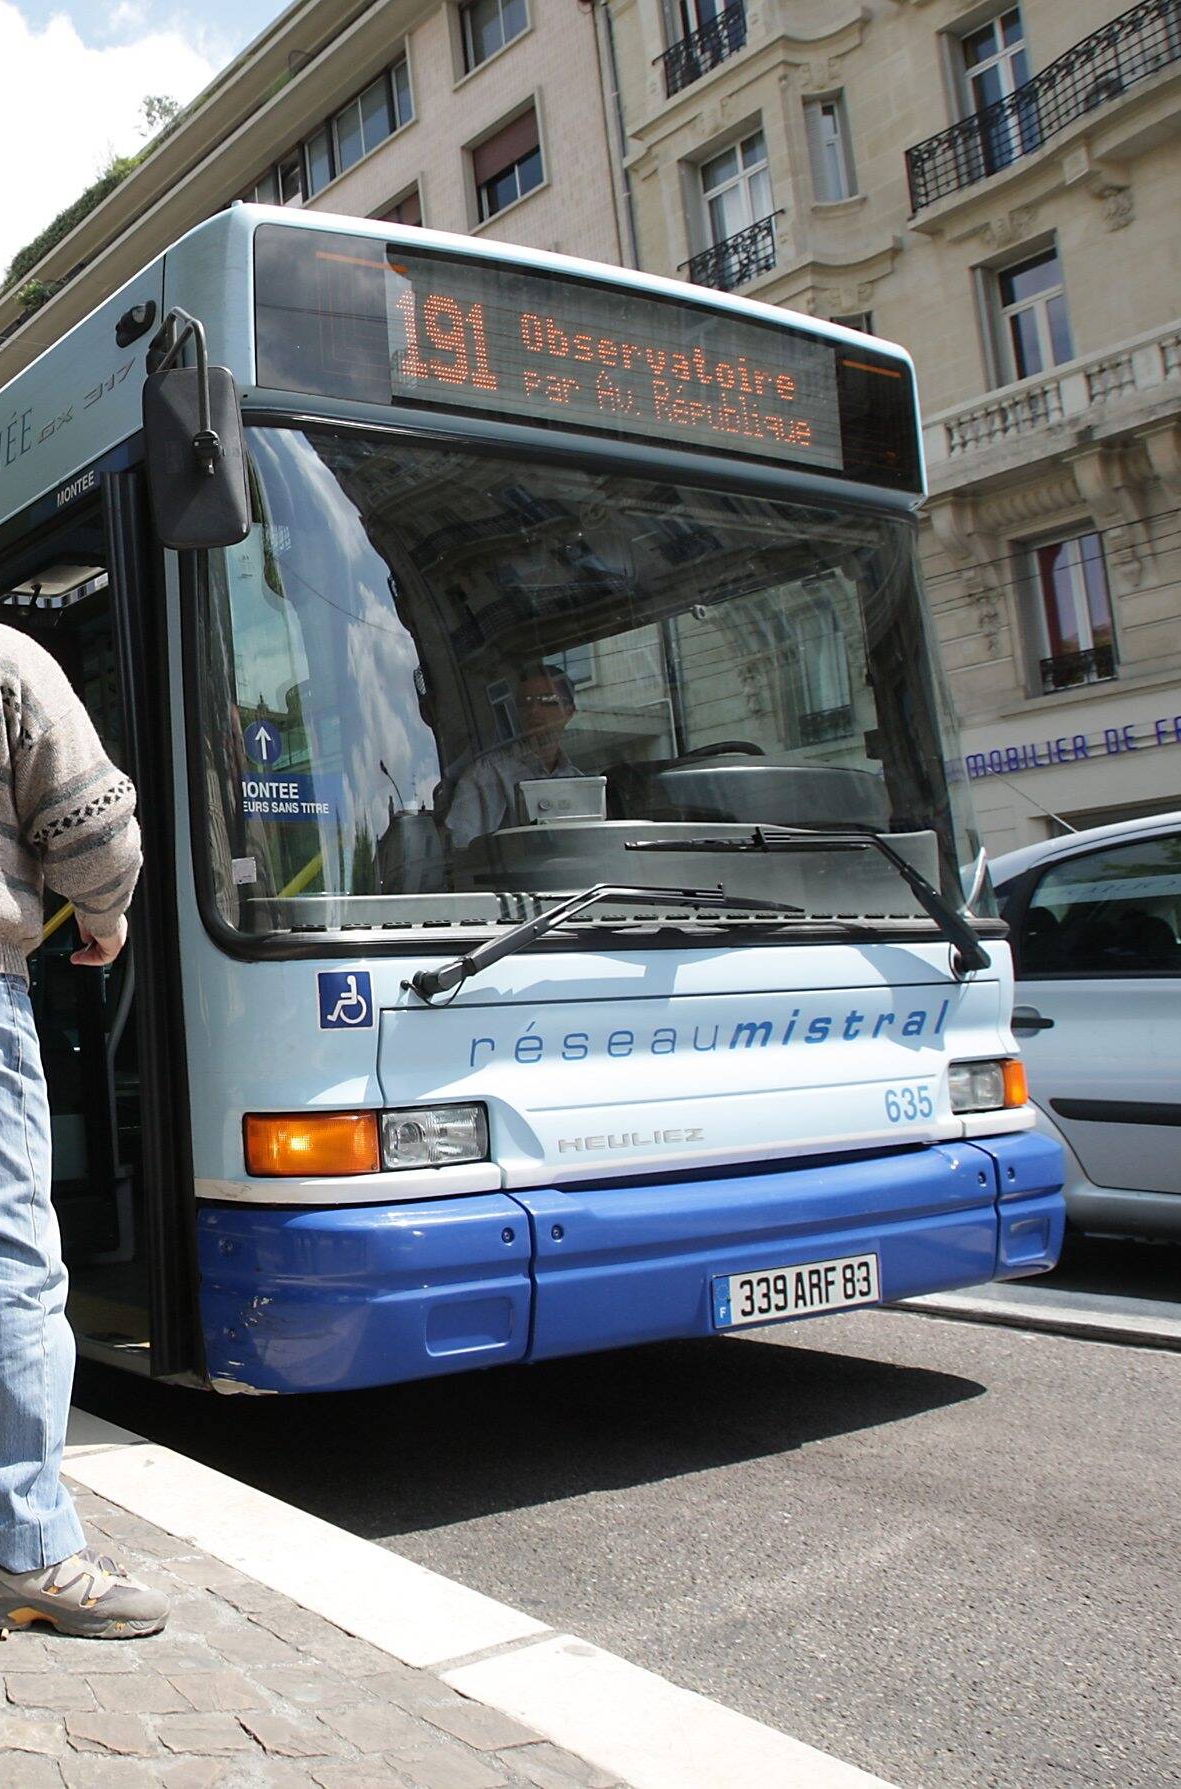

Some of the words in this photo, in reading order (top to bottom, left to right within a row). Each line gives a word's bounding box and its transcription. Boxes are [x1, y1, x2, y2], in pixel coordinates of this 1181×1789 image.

[395, 289, 499, 391] 191
[520, 312, 796, 401] Observatoire
[652, 378, 813, 447] République
[56, 470, 95, 508] MONTEE
[965, 735, 1088, 780] MOBILIER
[1104, 725, 1138, 755] DE
[272, 802, 299, 813] SANS
[301, 802, 329, 814] TITRE
[884, 1085, 933, 1123] 635
[558, 1128, 705, 1154] HEULIEZ
[719, 1307, 727, 1319] F
